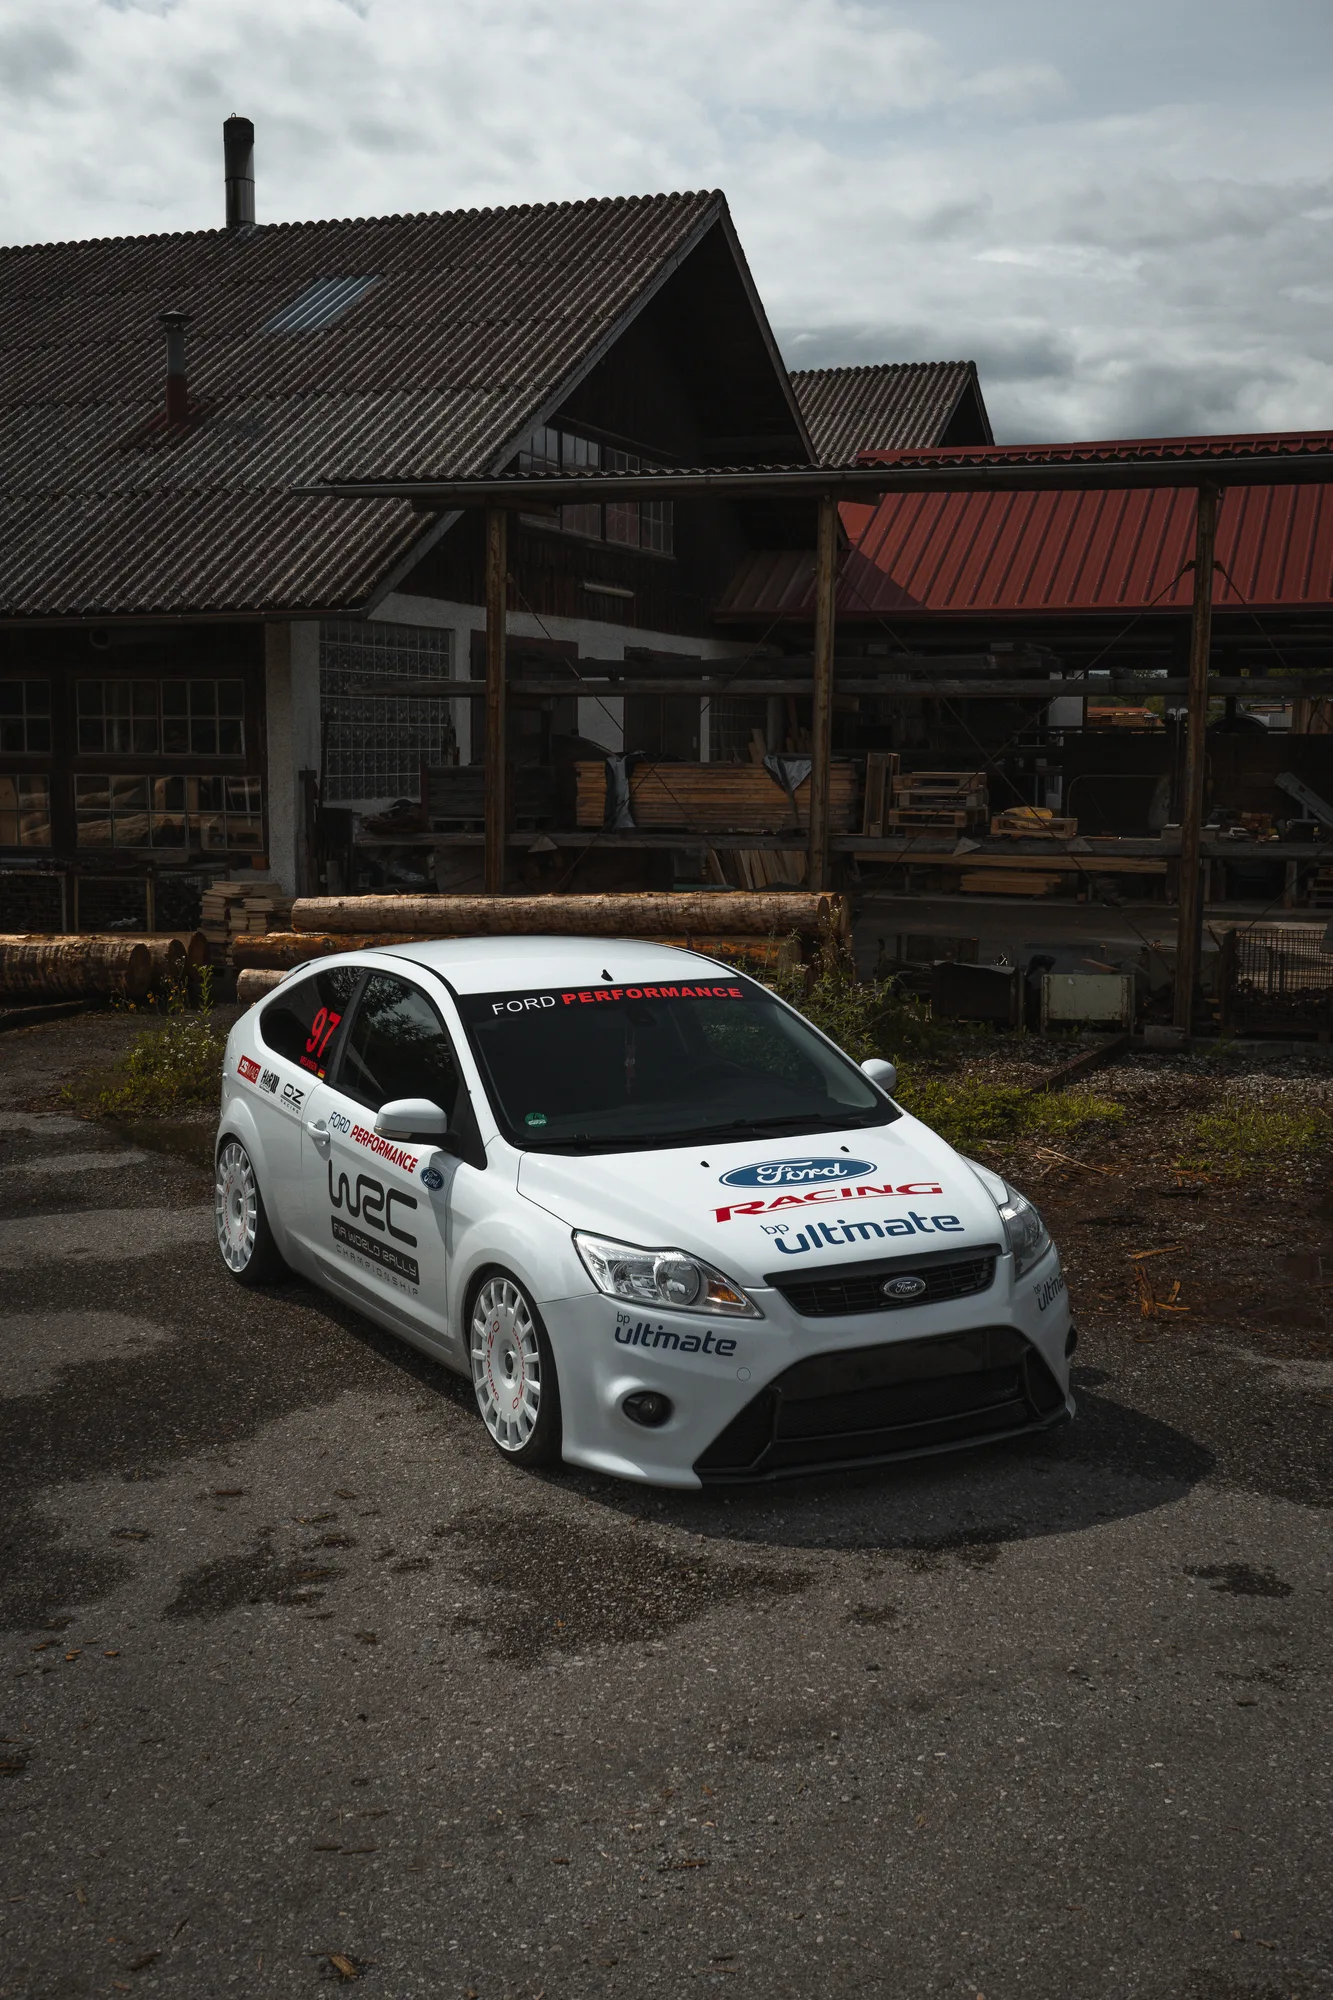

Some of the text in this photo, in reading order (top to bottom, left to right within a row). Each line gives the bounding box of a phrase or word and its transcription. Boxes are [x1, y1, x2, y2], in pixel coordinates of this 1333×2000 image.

[491, 986, 744, 1015] FORD PERFORMANCE
[306, 1006, 342, 1058] 97
[280, 1099, 300, 1114] RACING
[328, 1111, 419, 1174] FORD PERFORMANCE
[423, 1169, 441, 1189] Ford
[756, 1161, 848, 1184] Ford
[328, 1158, 418, 1249] WRC
[708, 1182, 944, 1224] RACING
[333, 1222, 417, 1277] FIA WORLD RALLY
[760, 1222, 790, 1236] bp
[774, 1211, 966, 1255] ultimate
[335, 1243, 419, 1296] CHAMPIONSHIP
[614, 1322, 737, 1357] ultimate
[616, 1311, 631, 1326] bp
[486, 1349, 500, 1402] RACING
